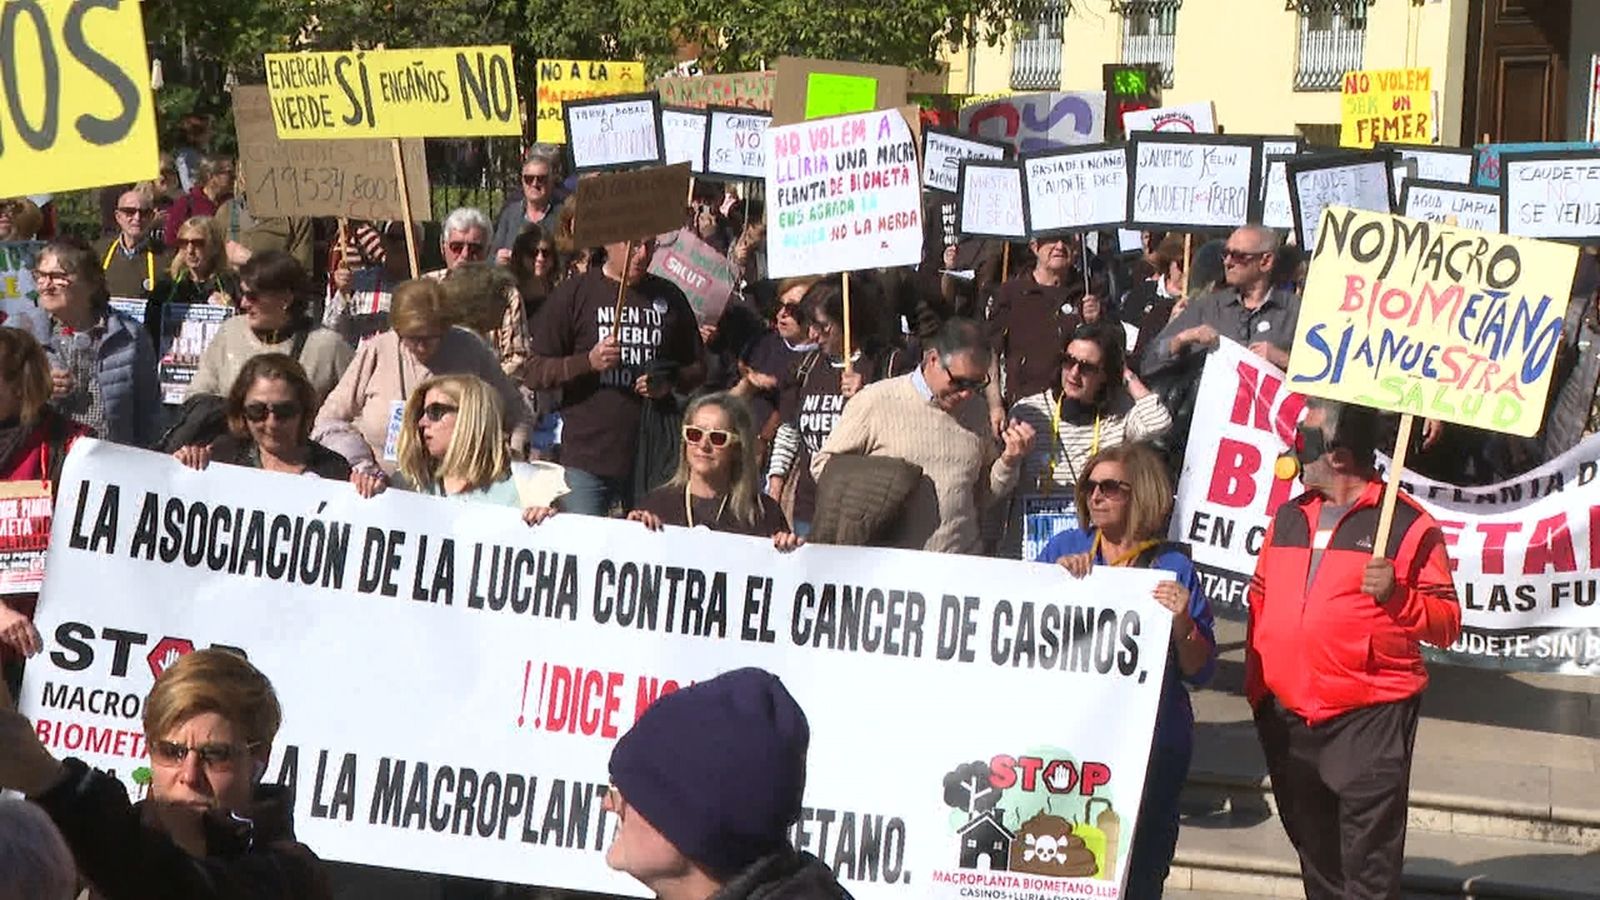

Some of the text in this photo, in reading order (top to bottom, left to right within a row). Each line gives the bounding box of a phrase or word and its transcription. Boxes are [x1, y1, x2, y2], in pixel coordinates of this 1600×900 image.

[541, 61, 608, 81] NO A LA
[1344, 72, 1430, 94] NO VOLEM
[268, 55, 332, 89] ENERGIA
[380, 60, 450, 103] ENGAÑOS
[456, 51, 512, 122] NO
[273, 94, 335, 130] VERDE
[1392, 95, 1412, 111] UN
[726, 116, 769, 130] CAUDET
[1357, 113, 1428, 143] FEMER
[734, 131, 761, 150] NO
[774, 115, 891, 161] NO VOLEM A
[929, 140, 962, 157] TIERRA
[741, 149, 765, 168] VEN
[835, 149, 867, 171] UNA
[877, 141, 915, 166] MACRO
[1037, 173, 1087, 196] CAUDETE
[1520, 166, 1600, 181] CAUDETE
[777, 181, 826, 208] PLANTA
[830, 177, 844, 197] DE
[1137, 183, 1196, 213] CAUDETE
[1413, 194, 1442, 208] AGUA
[831, 225, 848, 241] NO
[854, 218, 872, 235] LA
[878, 210, 918, 231] MERDA
[1521, 202, 1546, 225] SE
[1313, 210, 1385, 263] NO
[667, 256, 708, 289] SALUT
[598, 306, 661, 326] NI EN TU
[1338, 274, 1563, 384] BIOMETANO
[621, 347, 640, 365] EN
[1374, 328, 1527, 401] NUESTRA
[802, 394, 844, 411] NI EN
[1355, 376, 1523, 428] SALUD
[1578, 460, 1598, 486] D
[1188, 510, 1267, 556] EN C
[69, 480, 1147, 684] LA ASOCIACIÓN DE LA LUCHA CONTRA EL CANCER DE CASINOS,
[1465, 580, 1598, 612] LAS FU
[1535, 634, 1577, 660] SIN
[310, 749, 357, 822] LA
[369, 757, 614, 851] MACROPLANT
[795, 807, 911, 885] ETANO.
[932, 869, 1020, 888] MACROPLANTA
[1023, 878, 1094, 895] BIOMETANO
